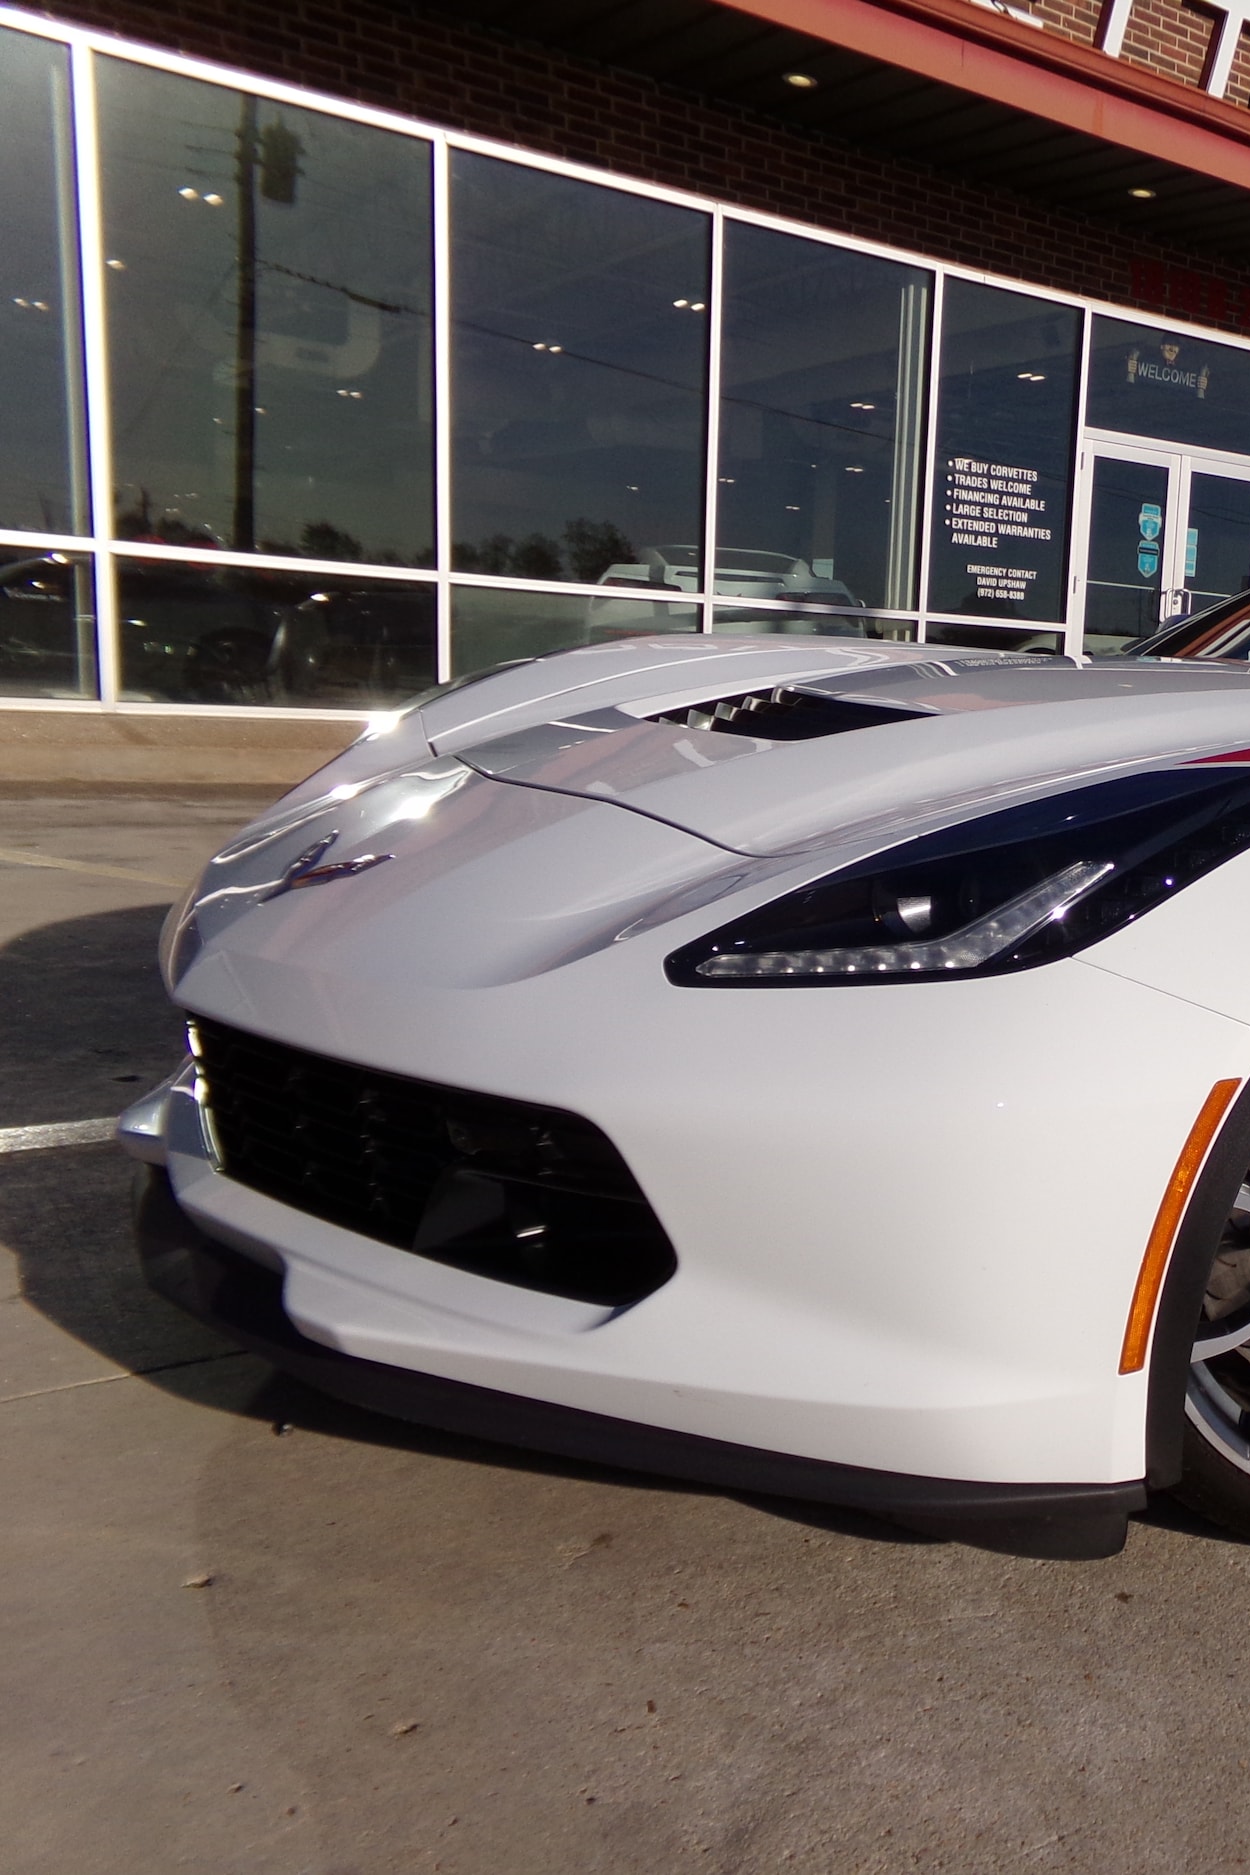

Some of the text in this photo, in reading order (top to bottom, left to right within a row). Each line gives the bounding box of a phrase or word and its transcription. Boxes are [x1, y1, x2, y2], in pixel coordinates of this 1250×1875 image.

[1138, 362, 1197, 388] WELCOME
[954, 457, 1038, 481] WE BUY CORVETTES
[954, 473, 1032, 495] TRADES WELCOME
[953, 488, 1046, 511] FINANCING AVAILABLE
[952, 502, 1028, 522] LARGE SELECTION
[951, 517, 1052, 540] EXTENDED WARRANTIES
[951, 532, 998, 548] AVAILABLE
[966, 564, 1038, 579] EMERGENCY CONTACT
[976, 576, 1027, 589] DAVID UPSHAW
[977, 587, 995, 598] (972)
